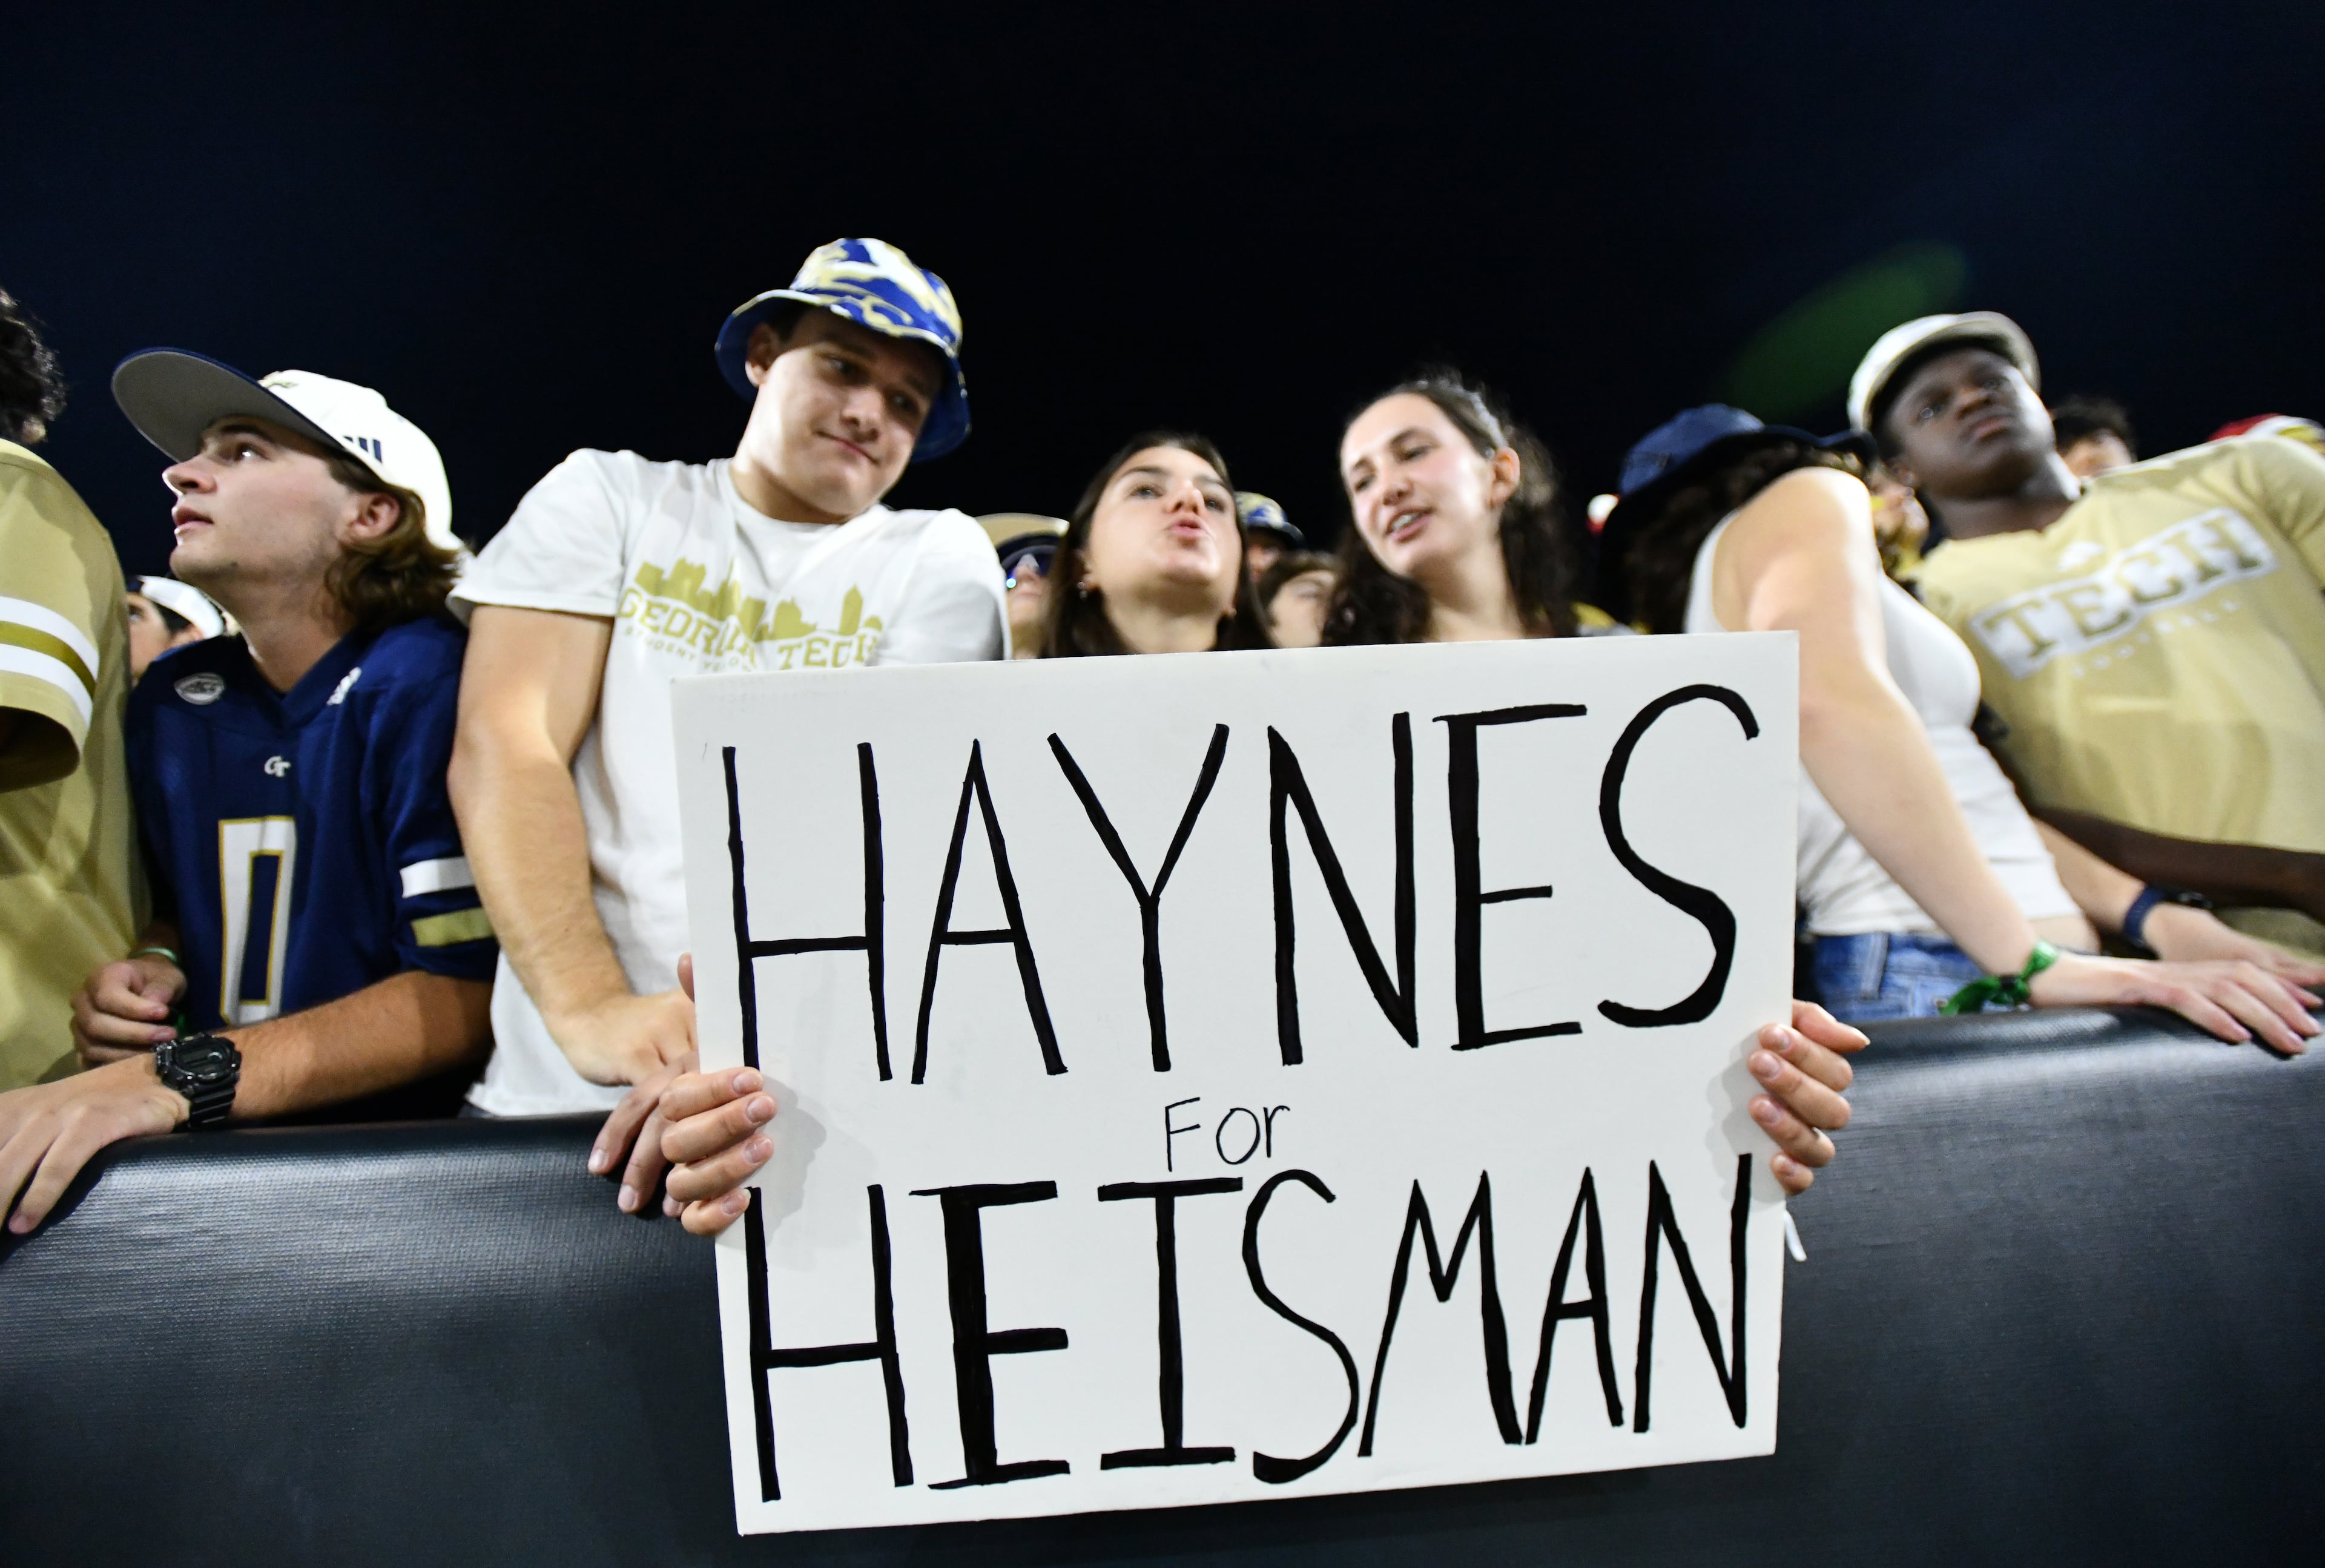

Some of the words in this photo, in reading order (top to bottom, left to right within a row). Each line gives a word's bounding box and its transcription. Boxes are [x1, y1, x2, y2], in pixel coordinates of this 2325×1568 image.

[1979, 512, 2267, 663] TECH
[264, 755, 291, 777] GT
[219, 815, 297, 1027] 0
[722, 684, 1760, 1085] HAYNES
[744, 1153, 1753, 1503] HEISMAN
